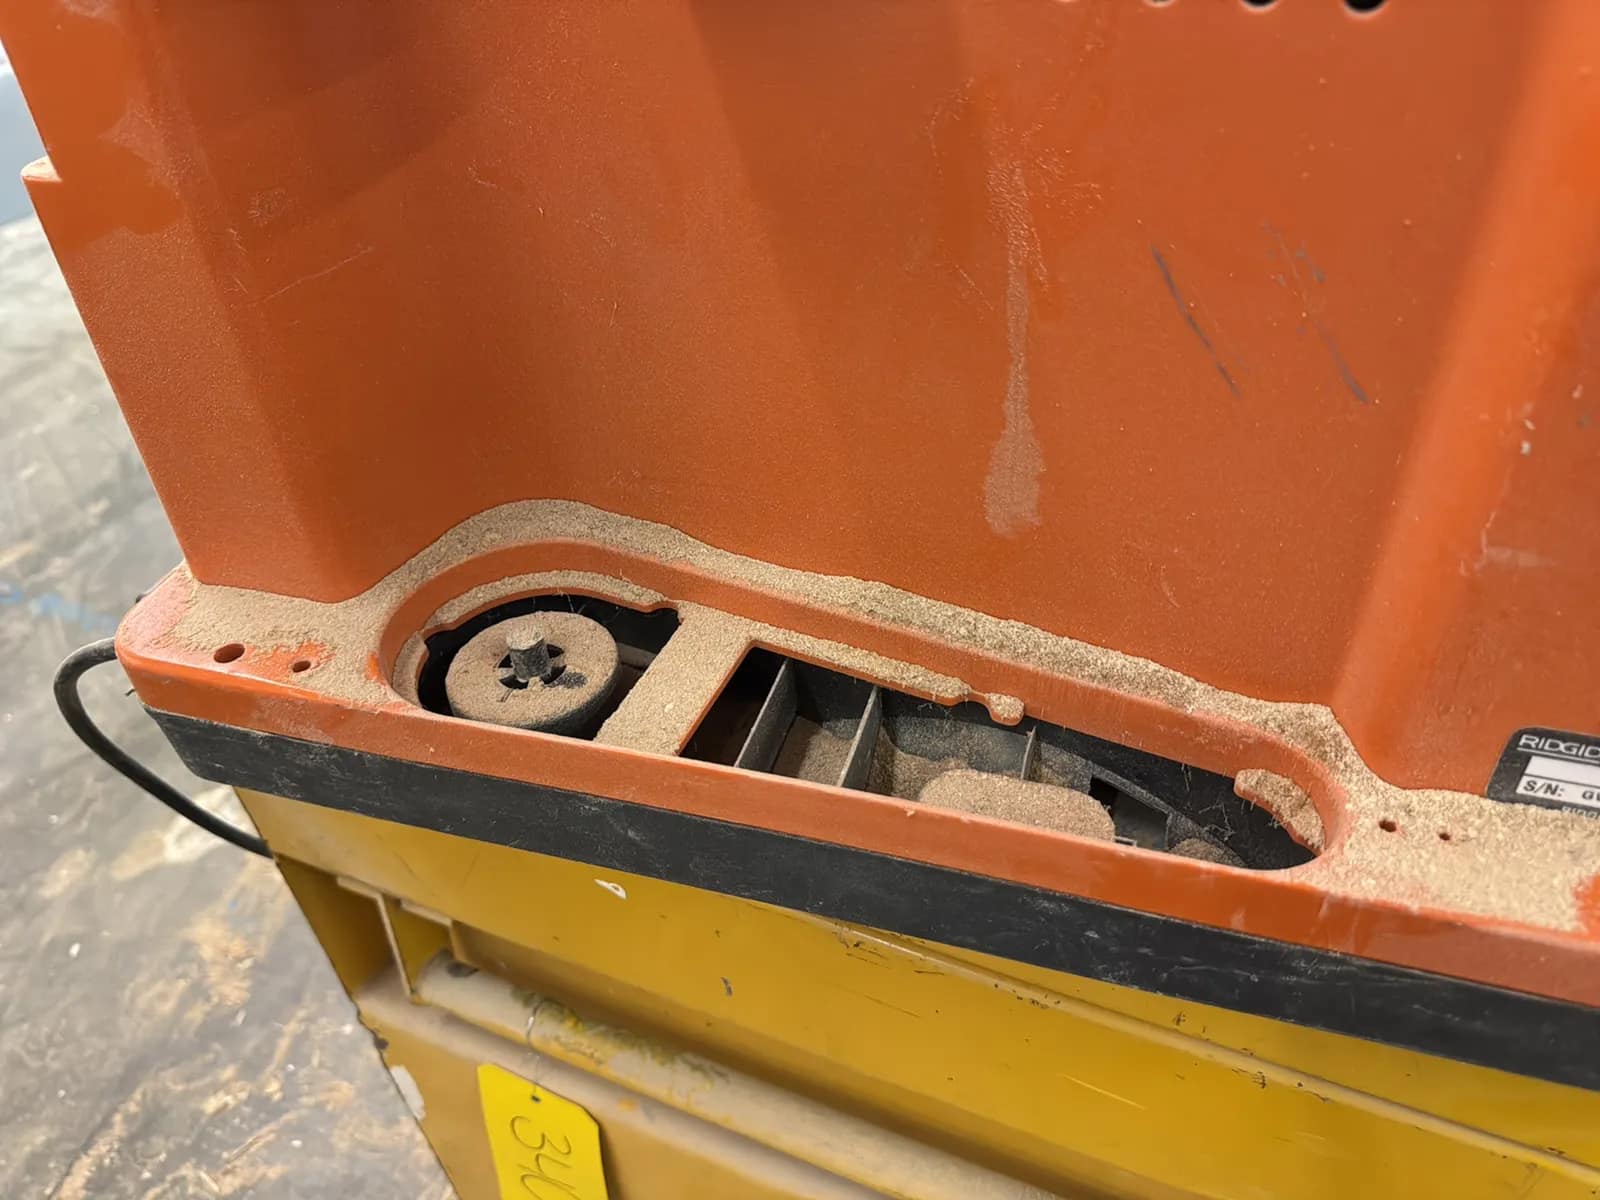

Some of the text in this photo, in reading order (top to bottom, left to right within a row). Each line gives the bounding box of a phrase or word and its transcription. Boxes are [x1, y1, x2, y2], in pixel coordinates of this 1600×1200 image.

[1518, 734, 1600, 758] RIDGID
[1523, 780, 1600, 802] S/N: G
